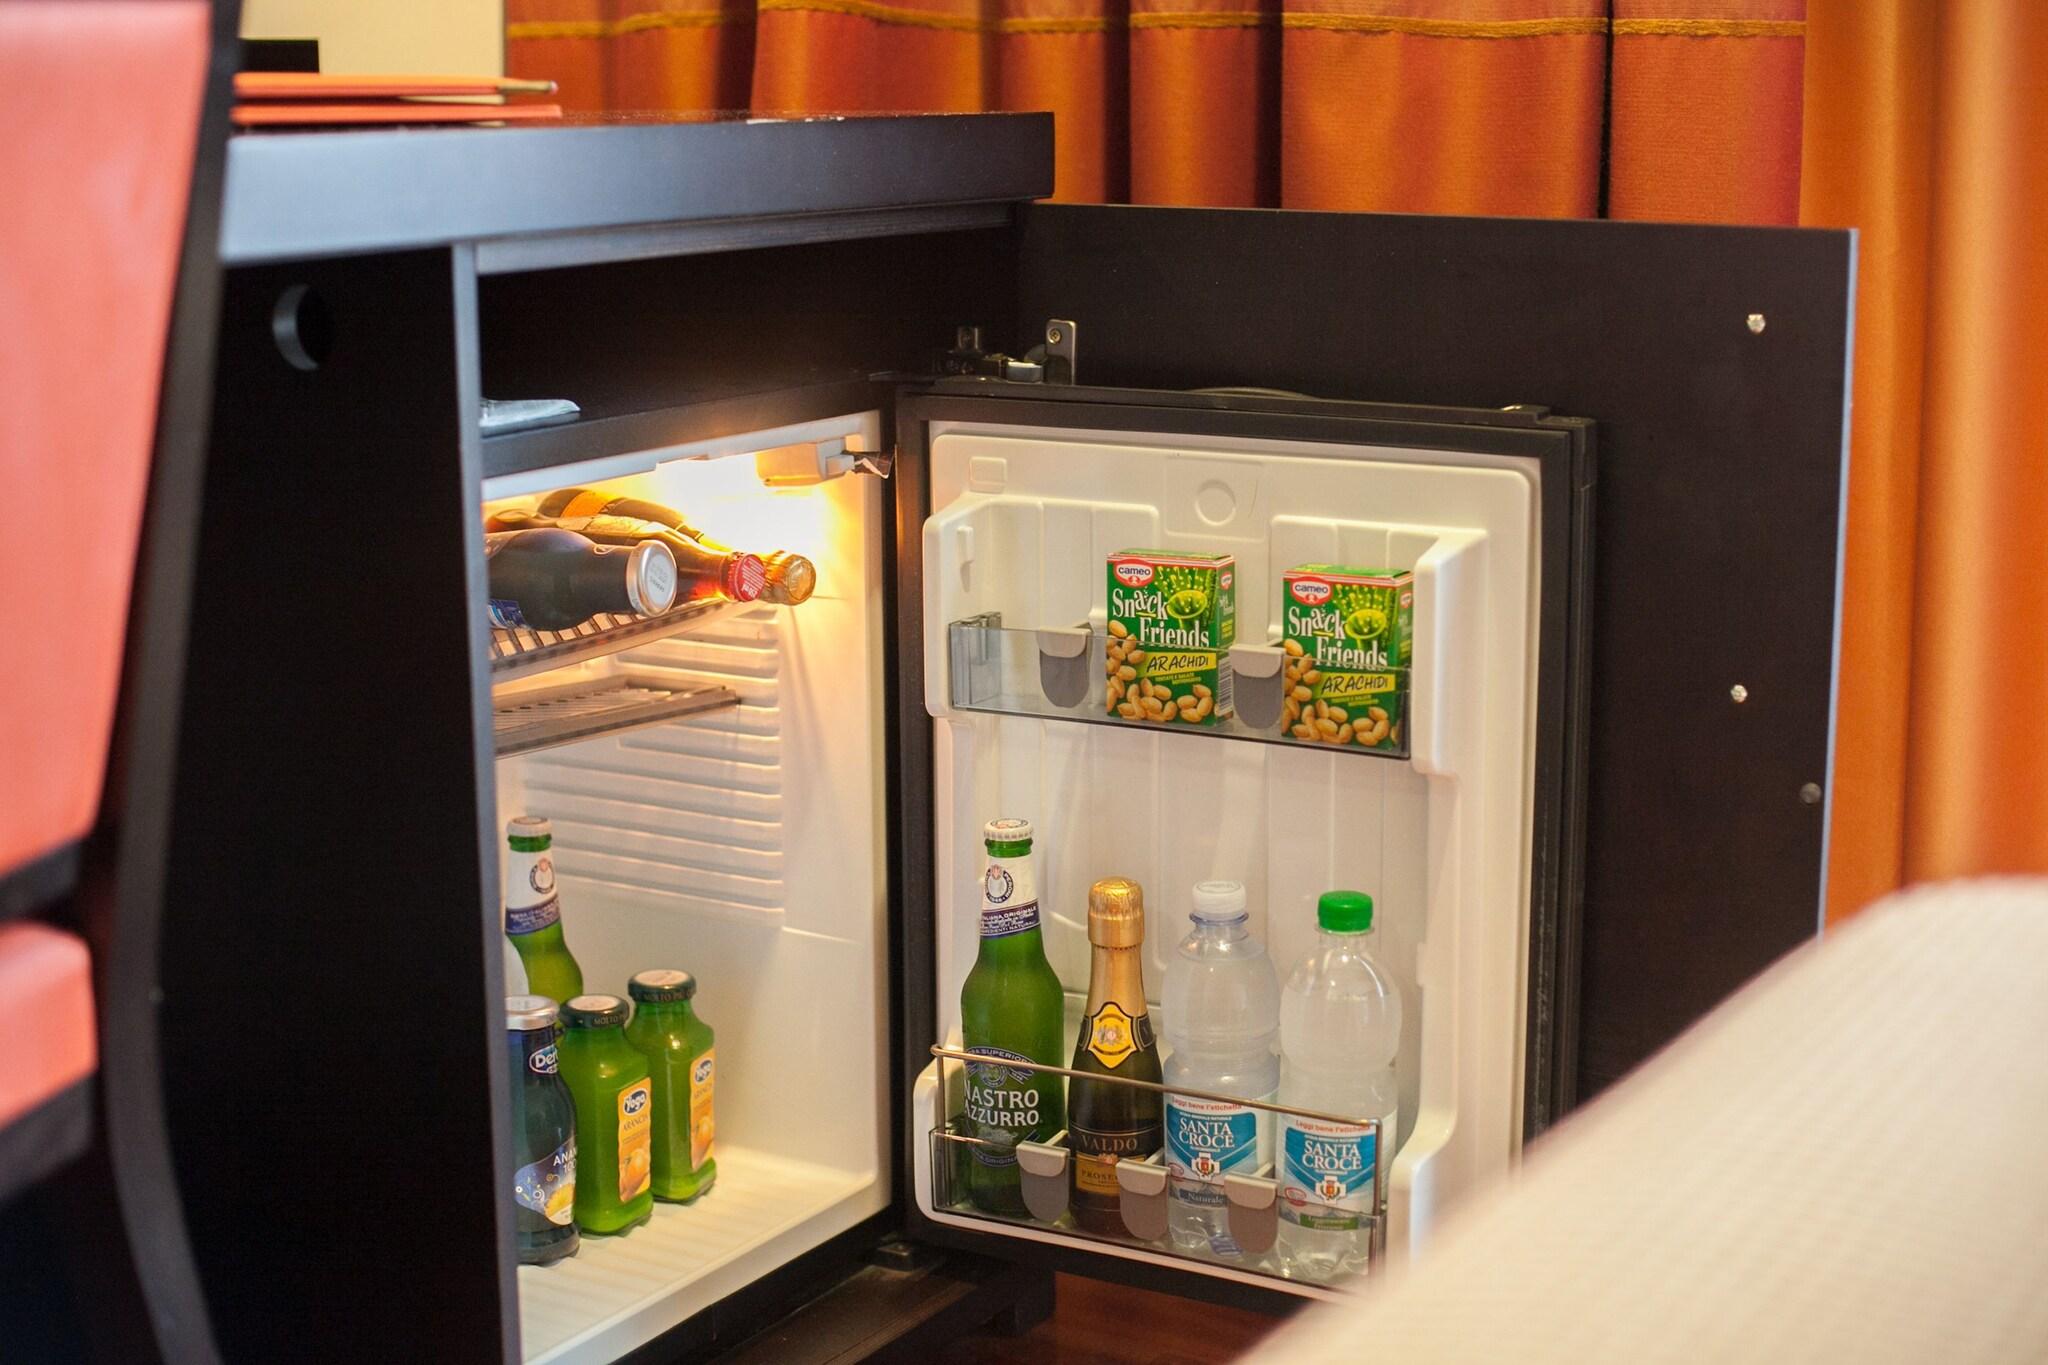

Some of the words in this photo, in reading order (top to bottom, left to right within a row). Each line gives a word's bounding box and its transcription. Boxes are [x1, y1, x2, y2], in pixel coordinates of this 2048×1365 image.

[1118, 565, 1151, 576] cameo
[1294, 583, 1329, 594] cameo
[1112, 588, 1168, 620] Snack
[1288, 606, 1347, 639] Snack
[1139, 617, 1210, 648] Friends
[1315, 637, 1388, 671] Friends
[1146, 655, 1209, 673] ARACHIDI
[1321, 675, 1388, 694] ARACHIDI
[981, 1048, 1030, 1064] SUPERIOR
[625, 1092, 646, 1113] Yoga
[964, 1079, 1039, 1109] NASTRO
[964, 1099, 1039, 1126] AZZURRO
[1180, 1117, 1232, 1135] SANTA
[1081, 1134, 1138, 1152] VALDO
[1178, 1130, 1235, 1148] CROCE
[1303, 1140, 1361, 1158] SANTA
[1302, 1153, 1362, 1170] CROCE
[1187, 1191, 1223, 1205] Naturale
